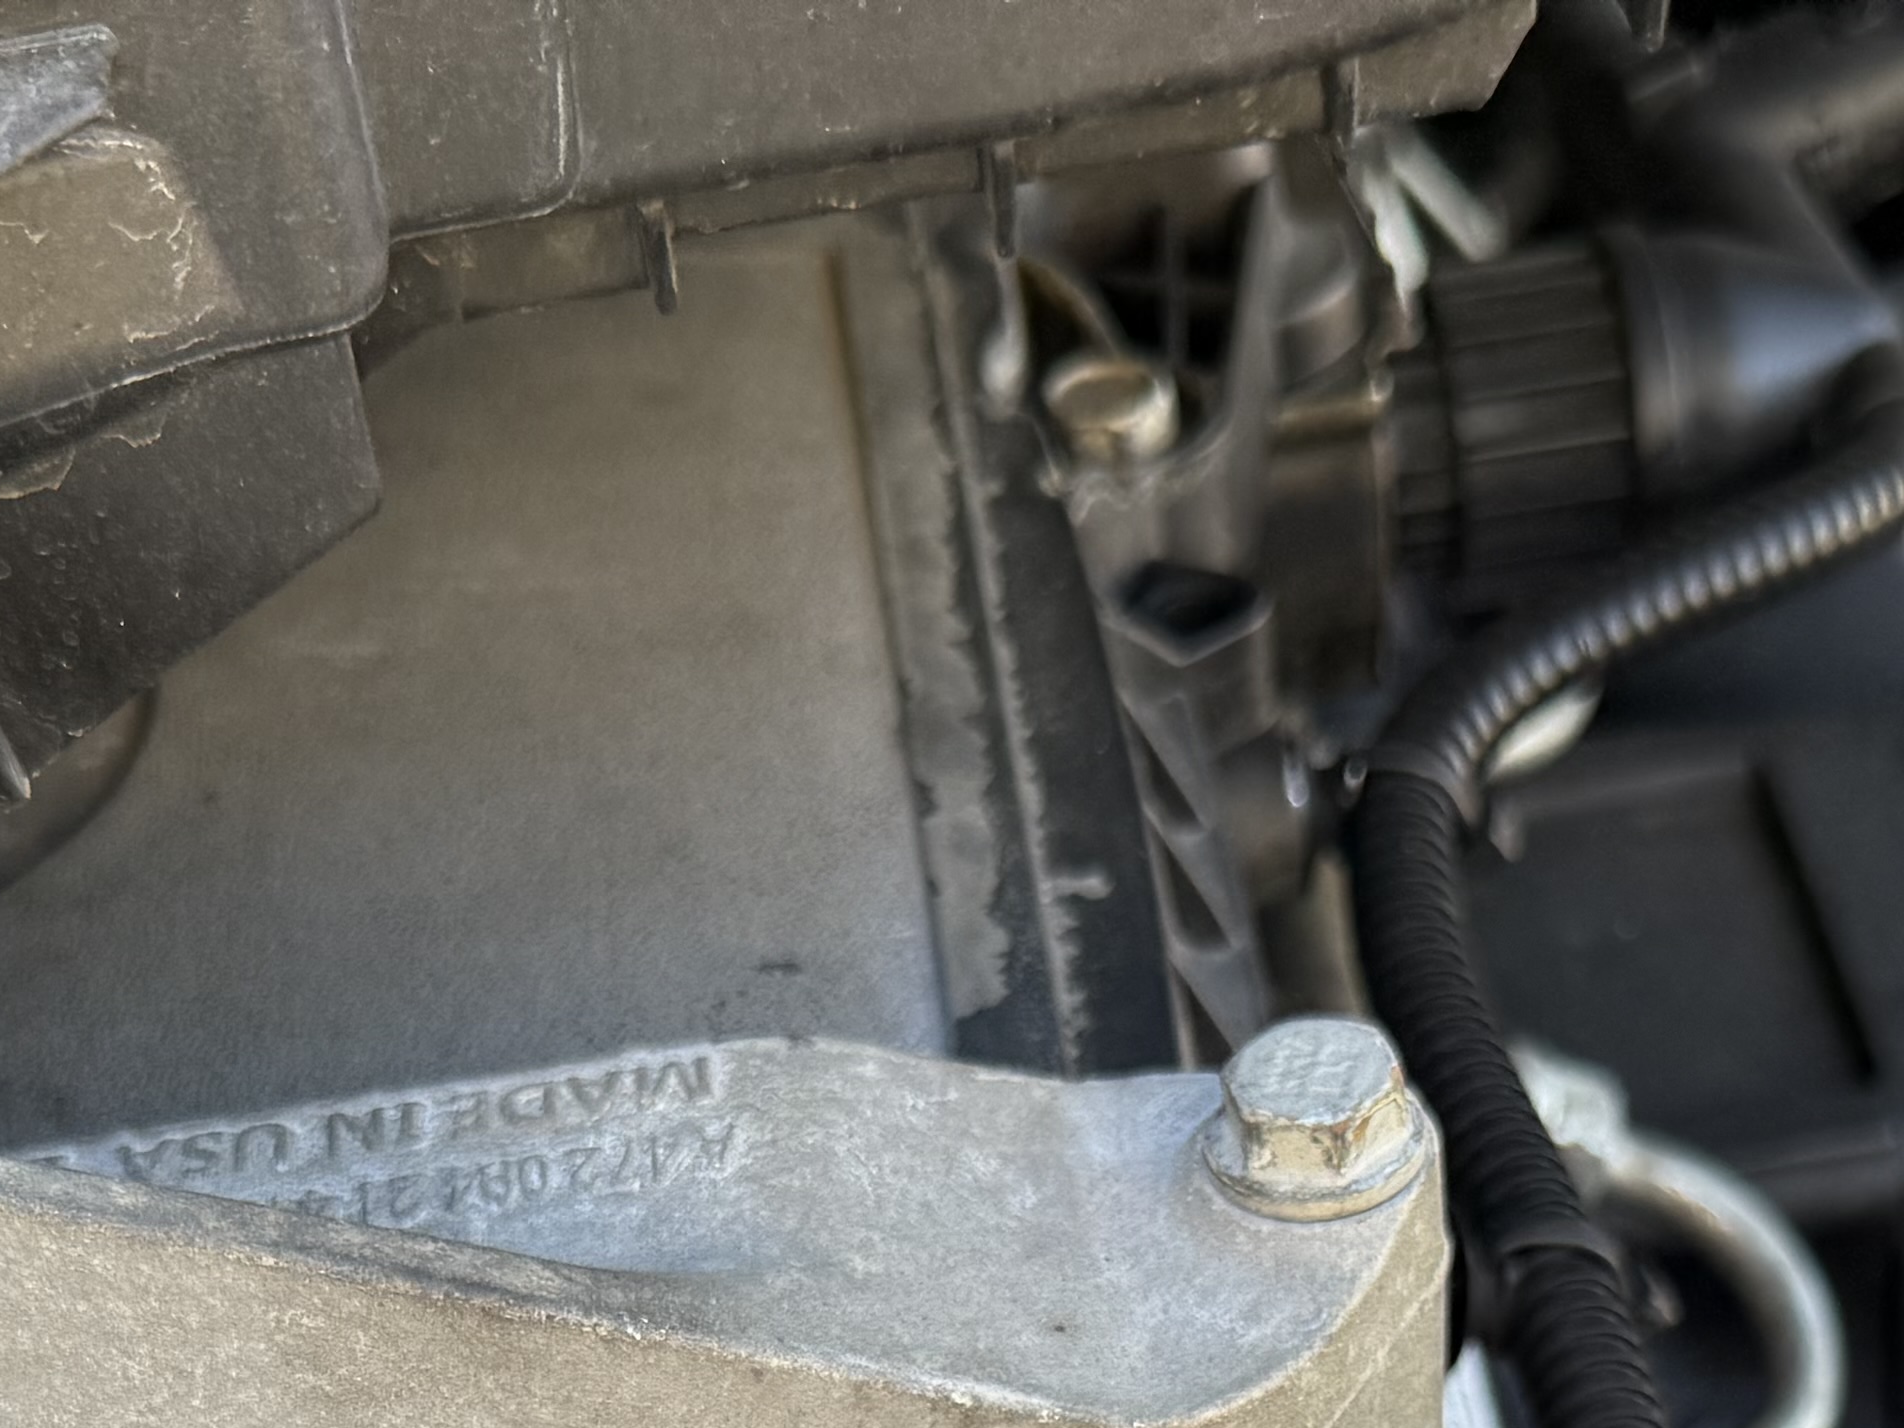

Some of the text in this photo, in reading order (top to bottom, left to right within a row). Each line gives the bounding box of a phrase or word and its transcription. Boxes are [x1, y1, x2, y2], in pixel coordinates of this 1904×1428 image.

[117, 1056, 715, 1184] MADE IN USA
